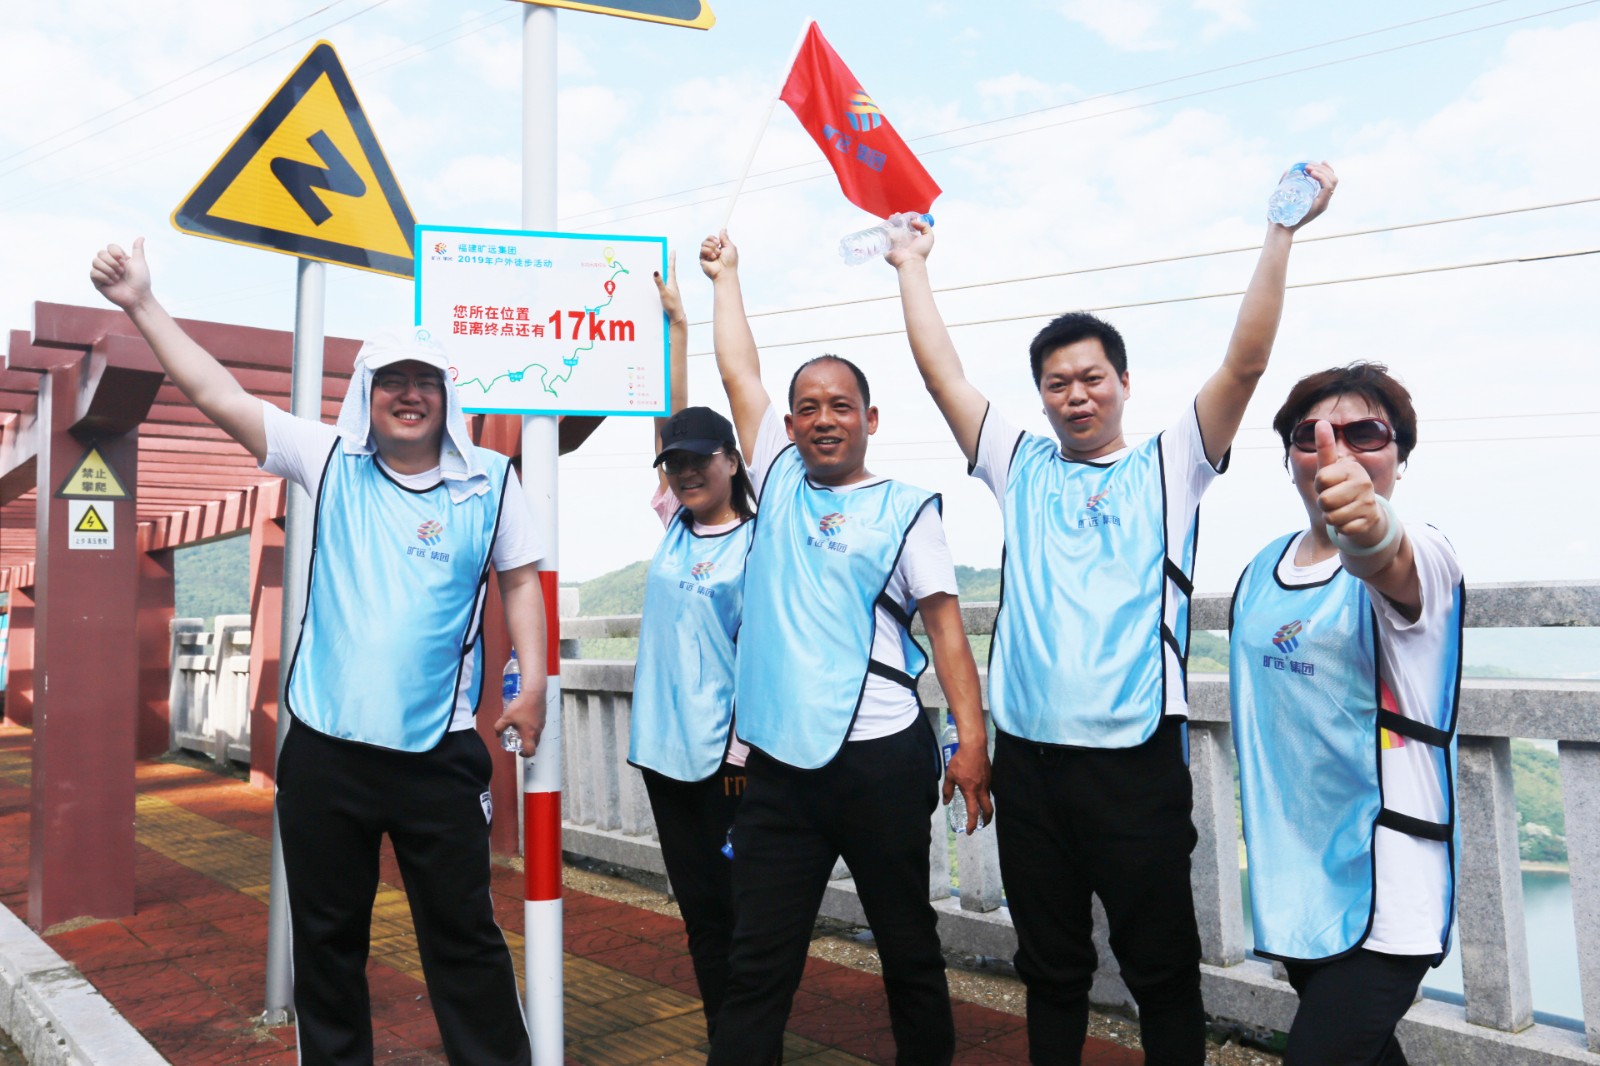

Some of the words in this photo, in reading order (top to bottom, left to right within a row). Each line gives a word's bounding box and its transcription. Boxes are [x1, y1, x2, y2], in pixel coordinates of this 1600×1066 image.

[855, 143, 887, 173] 集团
[458, 243, 517, 255] 福建旷远集团
[458, 255, 553, 268] 2019年户外徒步活动
[453, 305, 530, 321] 您所在位置
[453, 321, 545, 338] 距离终点还有
[548, 309, 636, 342] 17km
[81, 467, 107, 480] 禁止
[1102, 513, 1121, 527] 集团
[828, 540, 848, 554] 集团
[407, 546, 426, 558] 旷远
[431, 551, 450, 563] 集团
[696, 585, 715, 599] 集团
[1262, 655, 1285, 671] 旷远
[1290, 660, 1315, 677] 集团
